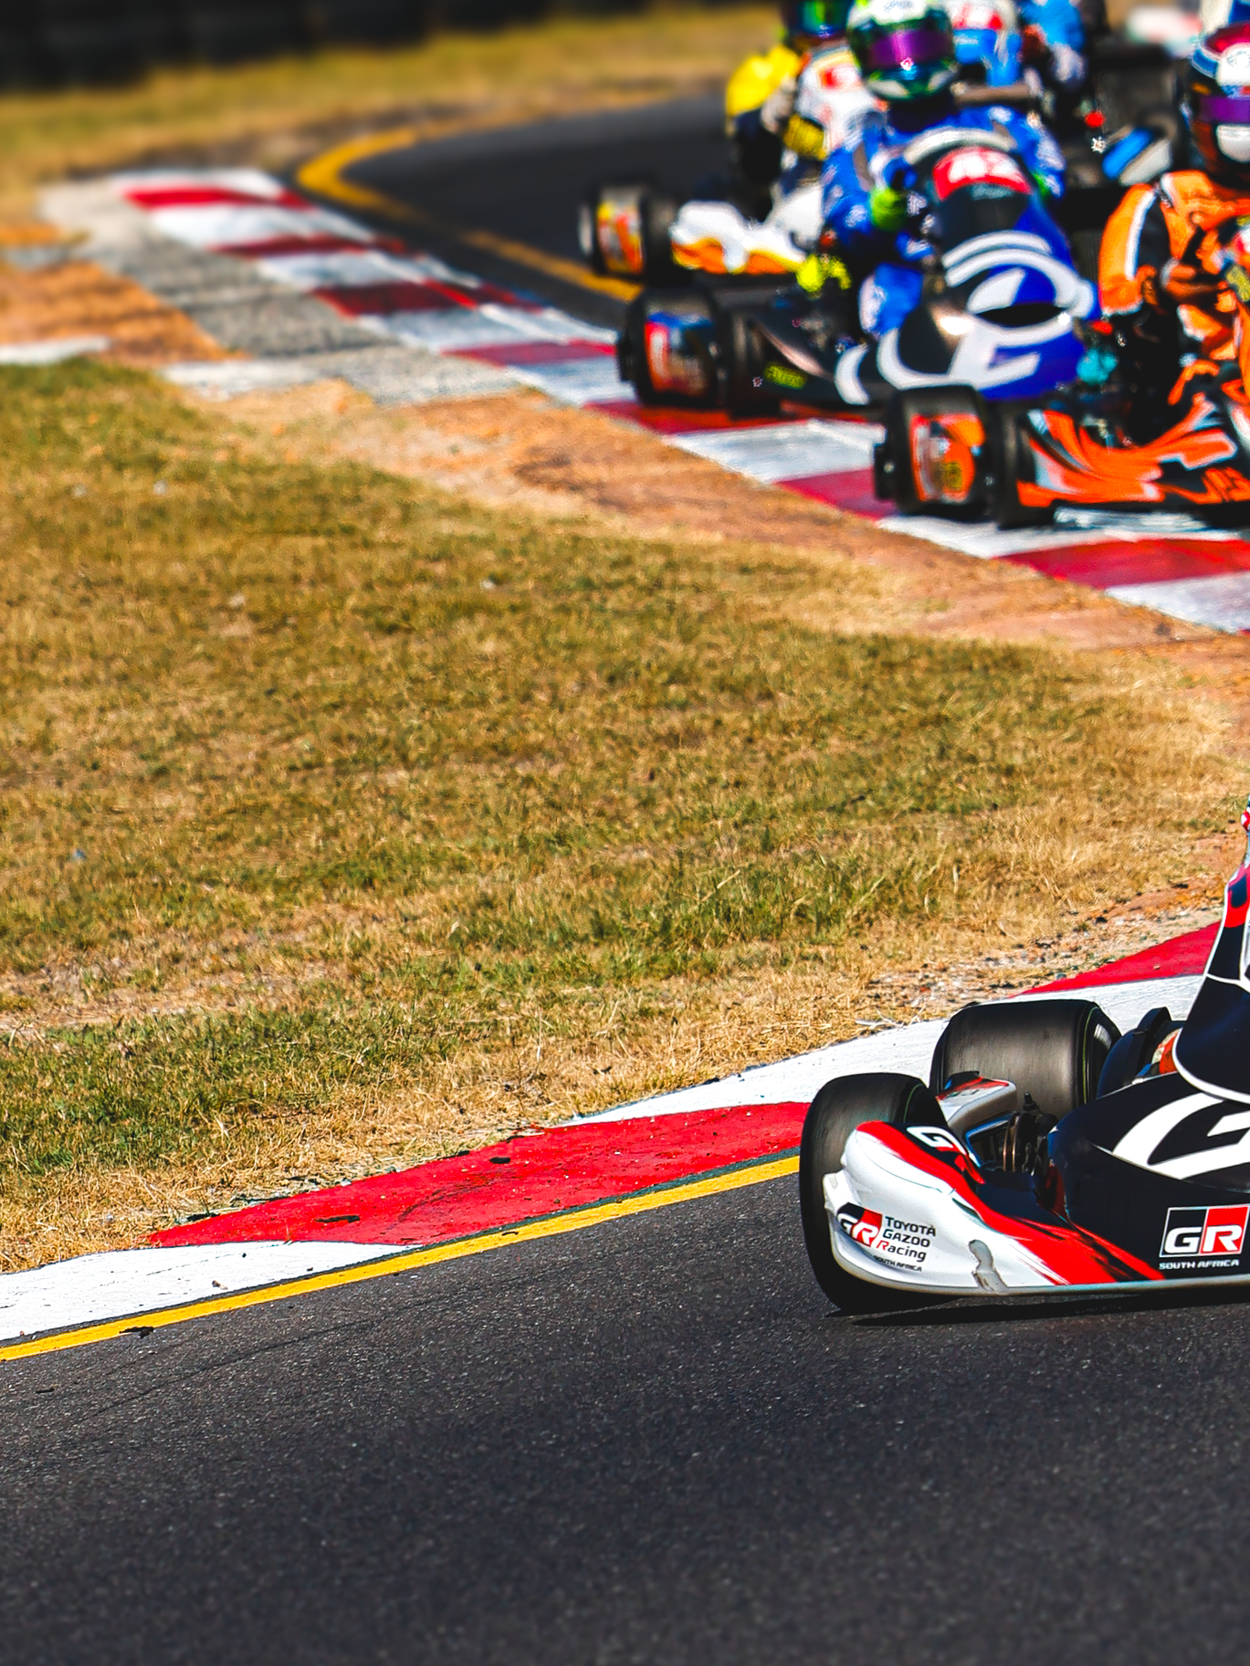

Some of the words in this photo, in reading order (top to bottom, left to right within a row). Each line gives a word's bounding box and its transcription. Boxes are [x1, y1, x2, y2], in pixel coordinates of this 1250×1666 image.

[836, 1211, 879, 1248] GR
[881, 1227, 931, 1249] GAZOO
[884, 1215, 937, 1238] TOYOTA
[1163, 1223, 1244, 1255] GR
[875, 1238, 928, 1264] Racing
[873, 1254, 896, 1267] SOUTH
[895, 1258, 923, 1273] AFRICA
[1158, 1260, 1196, 1271] SOUTH
[1196, 1258, 1241, 1269] AFRICA
